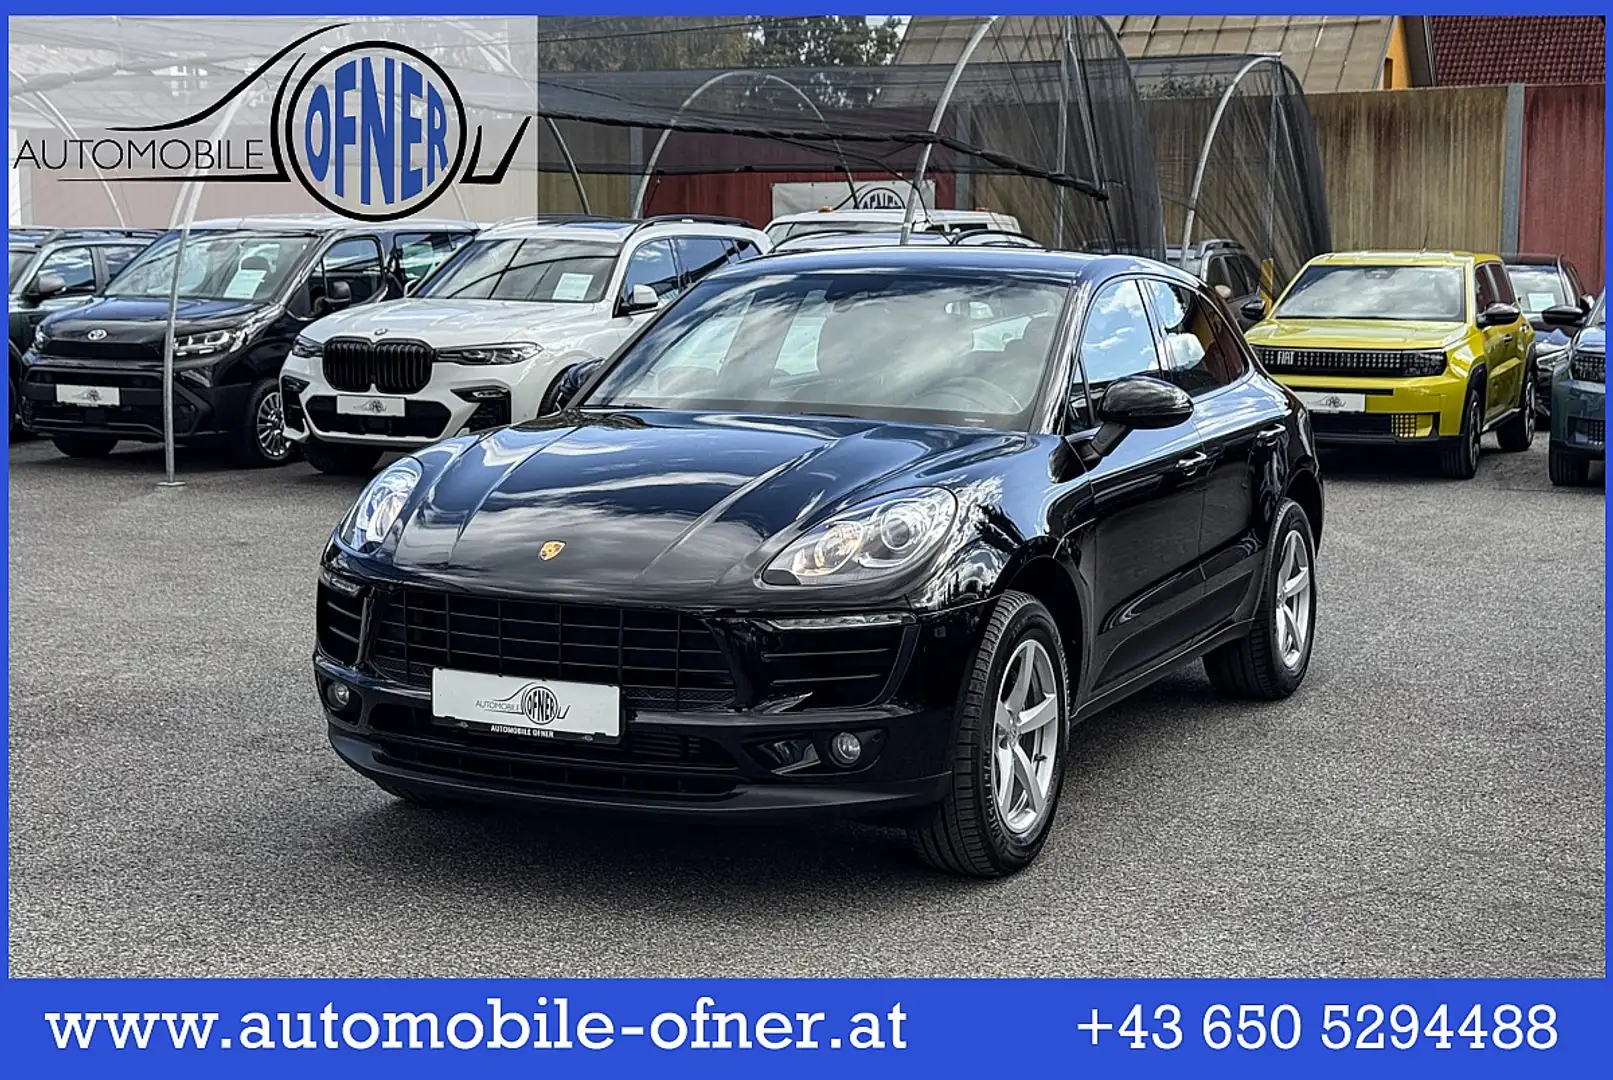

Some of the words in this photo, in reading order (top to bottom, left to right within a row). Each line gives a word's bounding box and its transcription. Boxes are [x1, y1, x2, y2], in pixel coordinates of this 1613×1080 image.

[1277, 351, 1295, 365] FIAT
[475, 700, 520, 711] AUTOMOBILE
[528, 690, 555, 722] OFNER
[490, 724, 532, 736] AUTOMOBILE
[532, 729, 554, 738] OFNER
